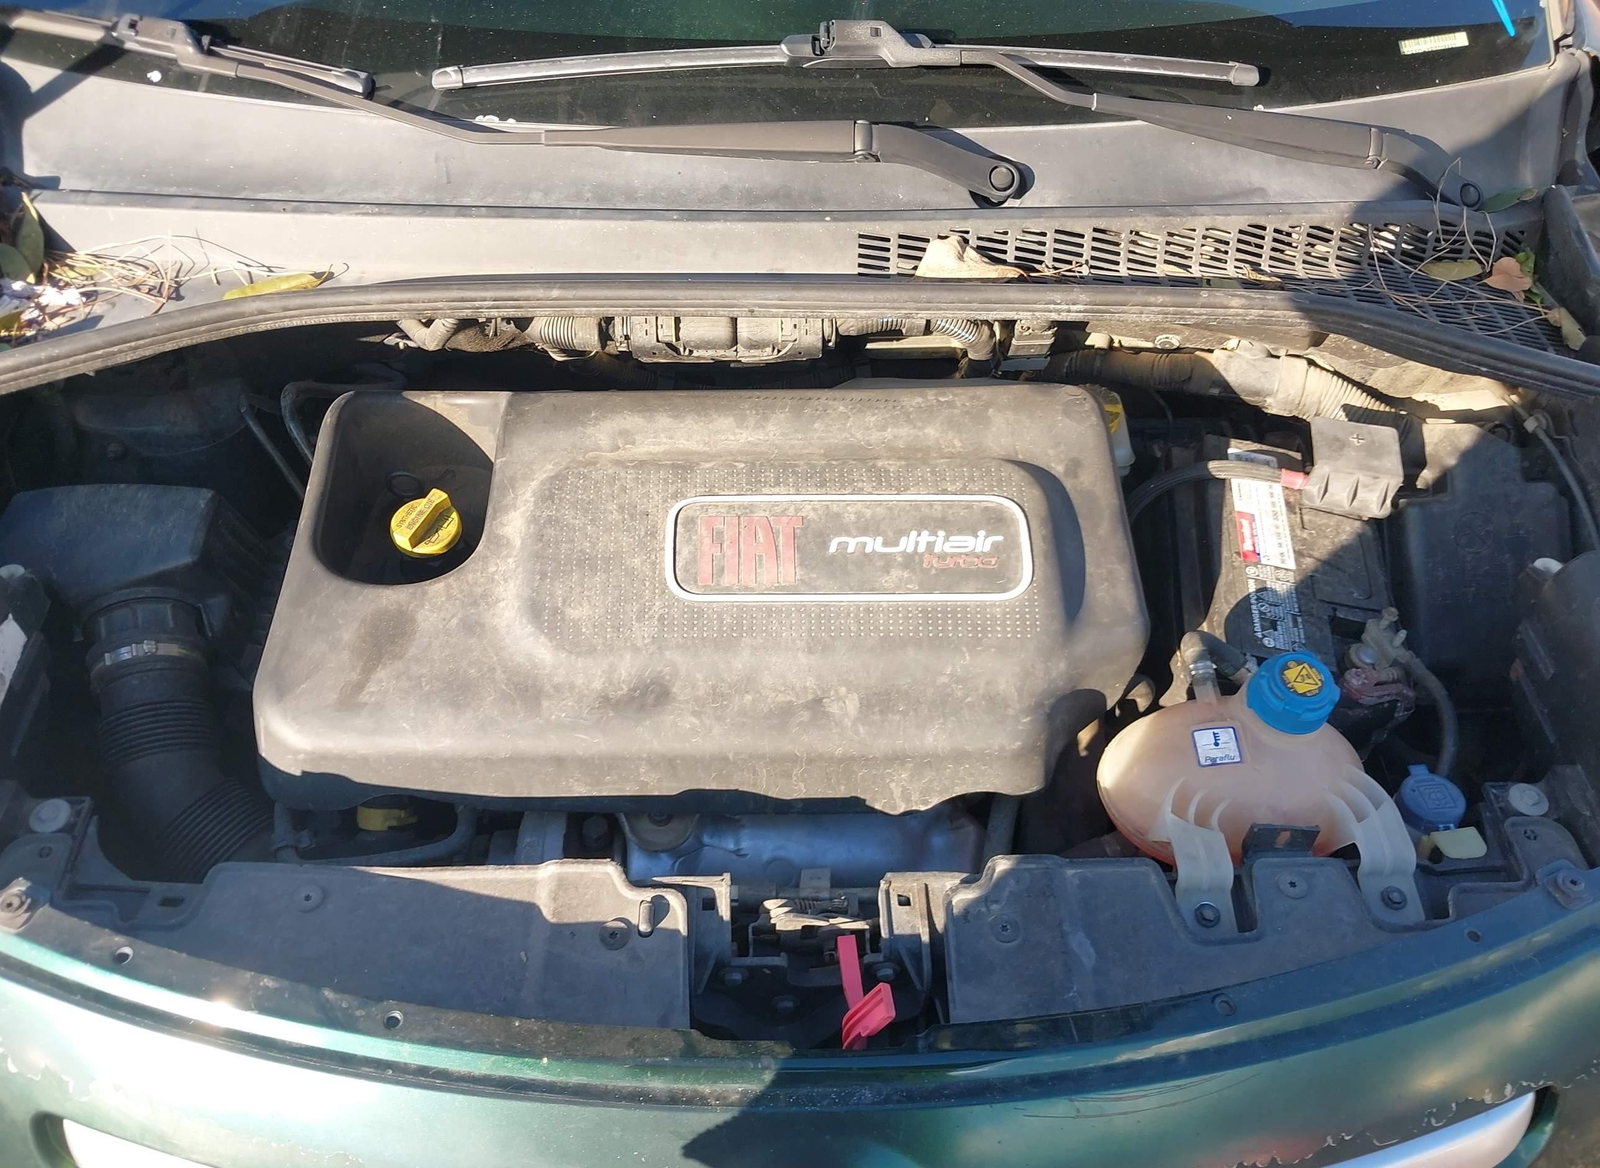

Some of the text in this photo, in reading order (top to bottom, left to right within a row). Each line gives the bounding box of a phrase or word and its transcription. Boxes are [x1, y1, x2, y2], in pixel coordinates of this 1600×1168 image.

[407, 509, 427, 530] ENGINE
[698, 515, 804, 585] FIAT
[828, 530, 1004, 554] multiair
[923, 553, 999, 569] turbo
[1205, 754, 1236, 763] Paraflu
